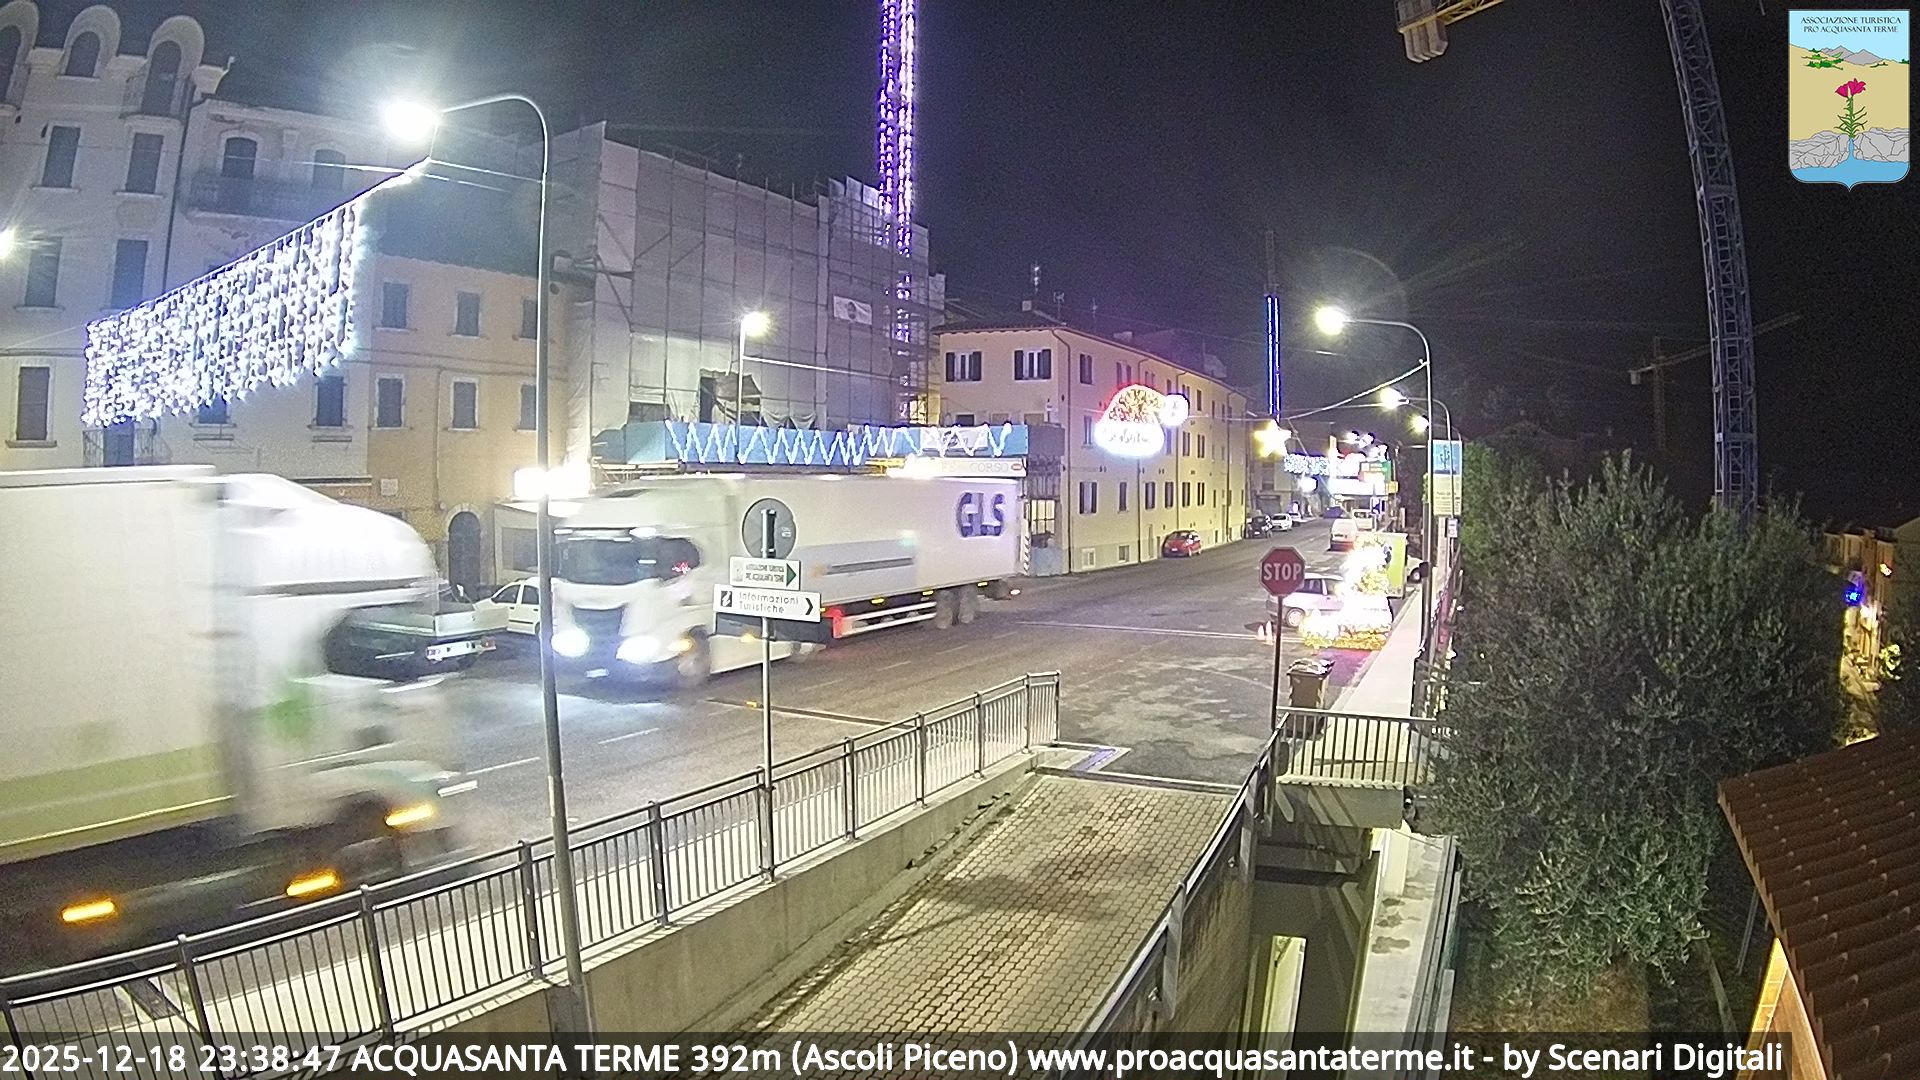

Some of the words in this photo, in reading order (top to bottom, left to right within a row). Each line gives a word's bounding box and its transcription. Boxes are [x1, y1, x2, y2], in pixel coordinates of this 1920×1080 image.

[969, 463, 1009, 473] CORSO
[956, 492, 1005, 537] GLS
[1263, 562, 1302, 581] STOP
[739, 591, 799, 605] Informazioni
[739, 600, 785, 614] Turistiche
